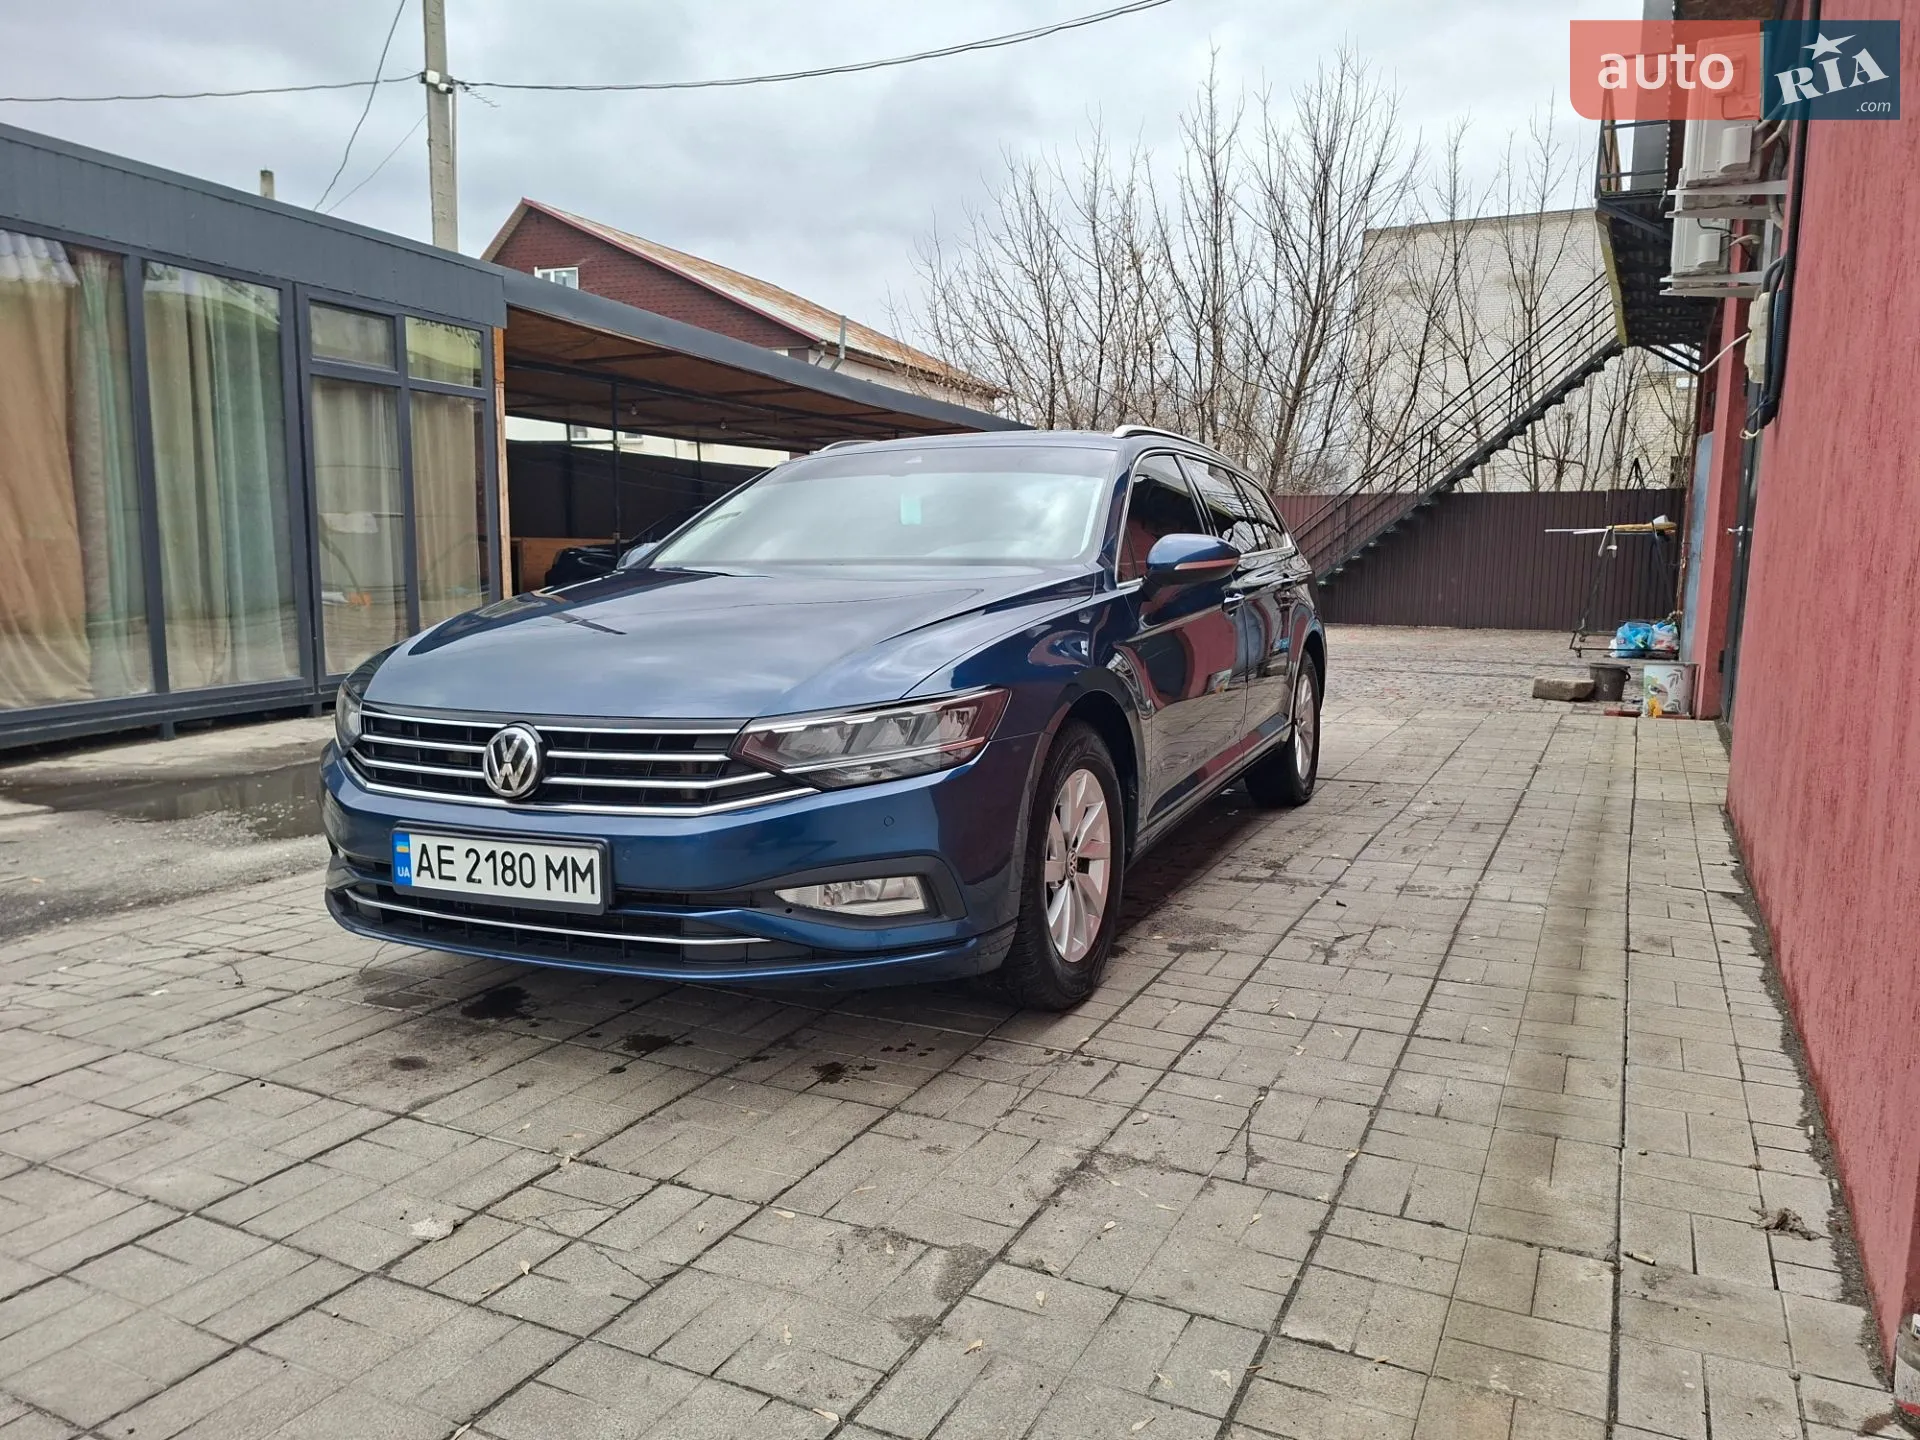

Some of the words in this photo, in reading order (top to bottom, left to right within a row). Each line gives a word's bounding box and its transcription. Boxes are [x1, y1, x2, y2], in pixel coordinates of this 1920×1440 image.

[397, 865, 411, 878] UA
[416, 843, 456, 881] AE
[465, 847, 536, 889] 2180
[545, 854, 595, 895] MM
